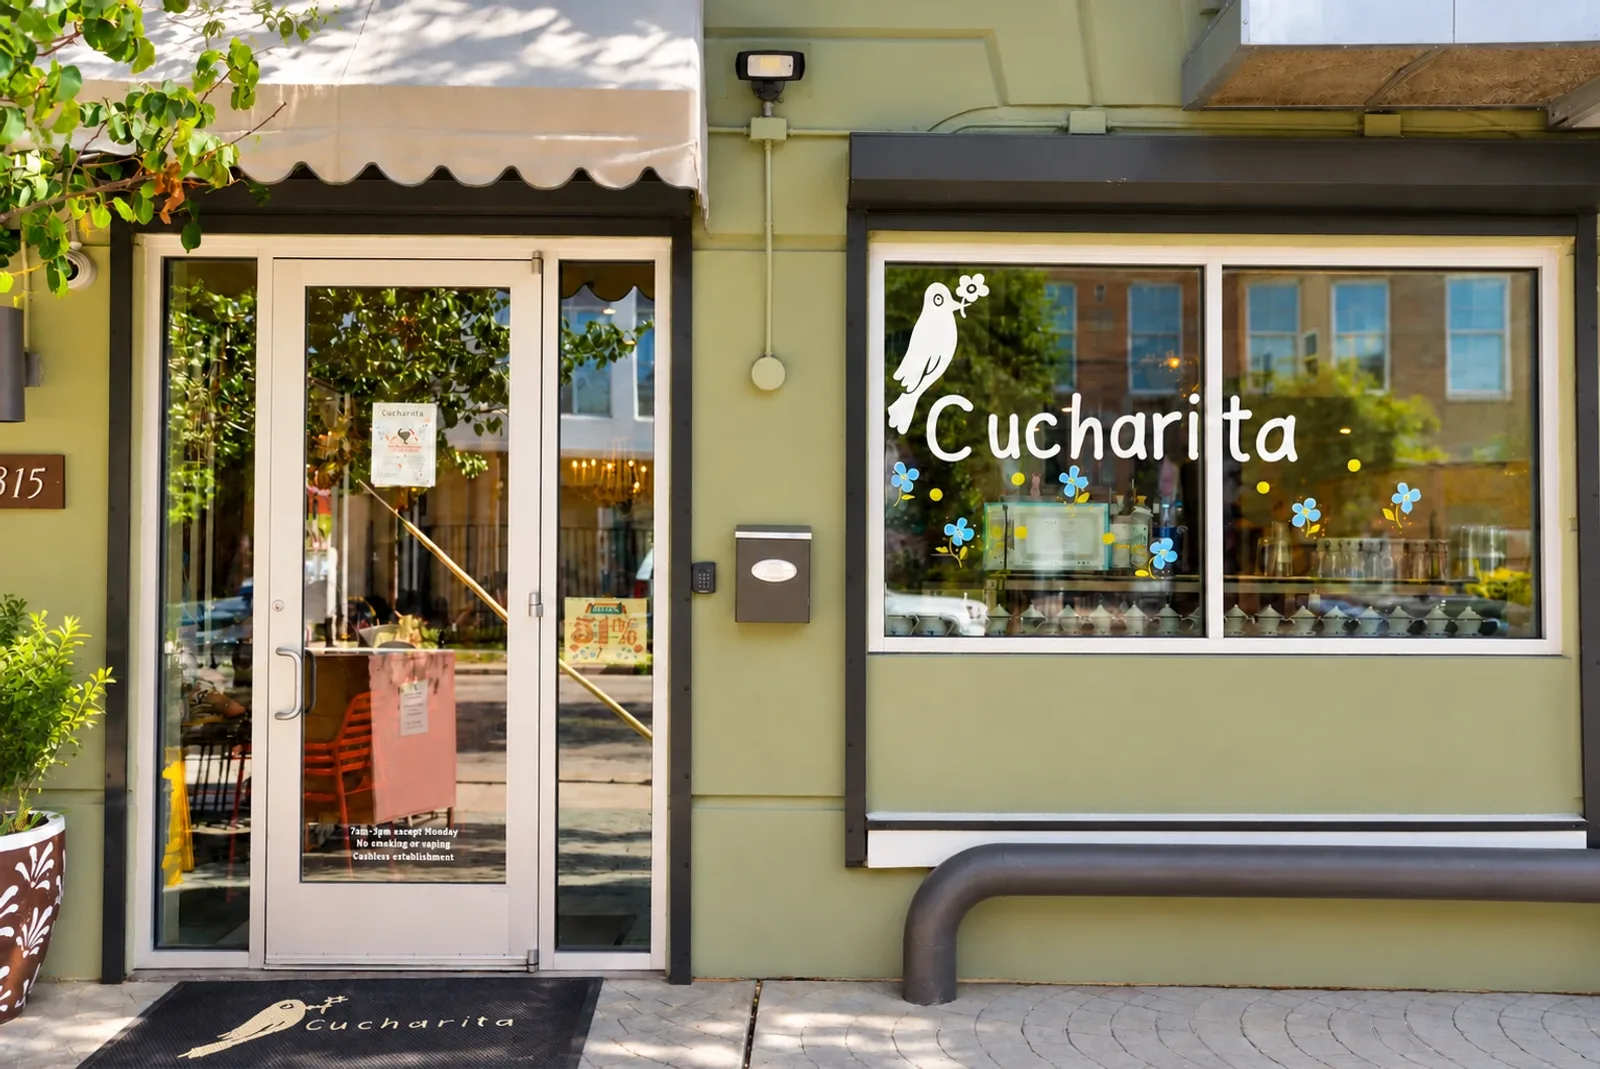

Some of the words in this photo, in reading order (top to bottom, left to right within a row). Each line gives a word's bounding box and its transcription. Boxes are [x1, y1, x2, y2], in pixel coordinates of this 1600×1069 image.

[925, 391, 1298, 463] Cucharita
[394, 827, 422, 838] except
[424, 827, 459, 838] Monday
[356, 839, 369, 848] No
[421, 839, 451, 850] vaping
[352, 852, 390, 861] Cashless
[392, 852, 455, 861] establishment
[305, 1014, 515, 1032] Cucharita
